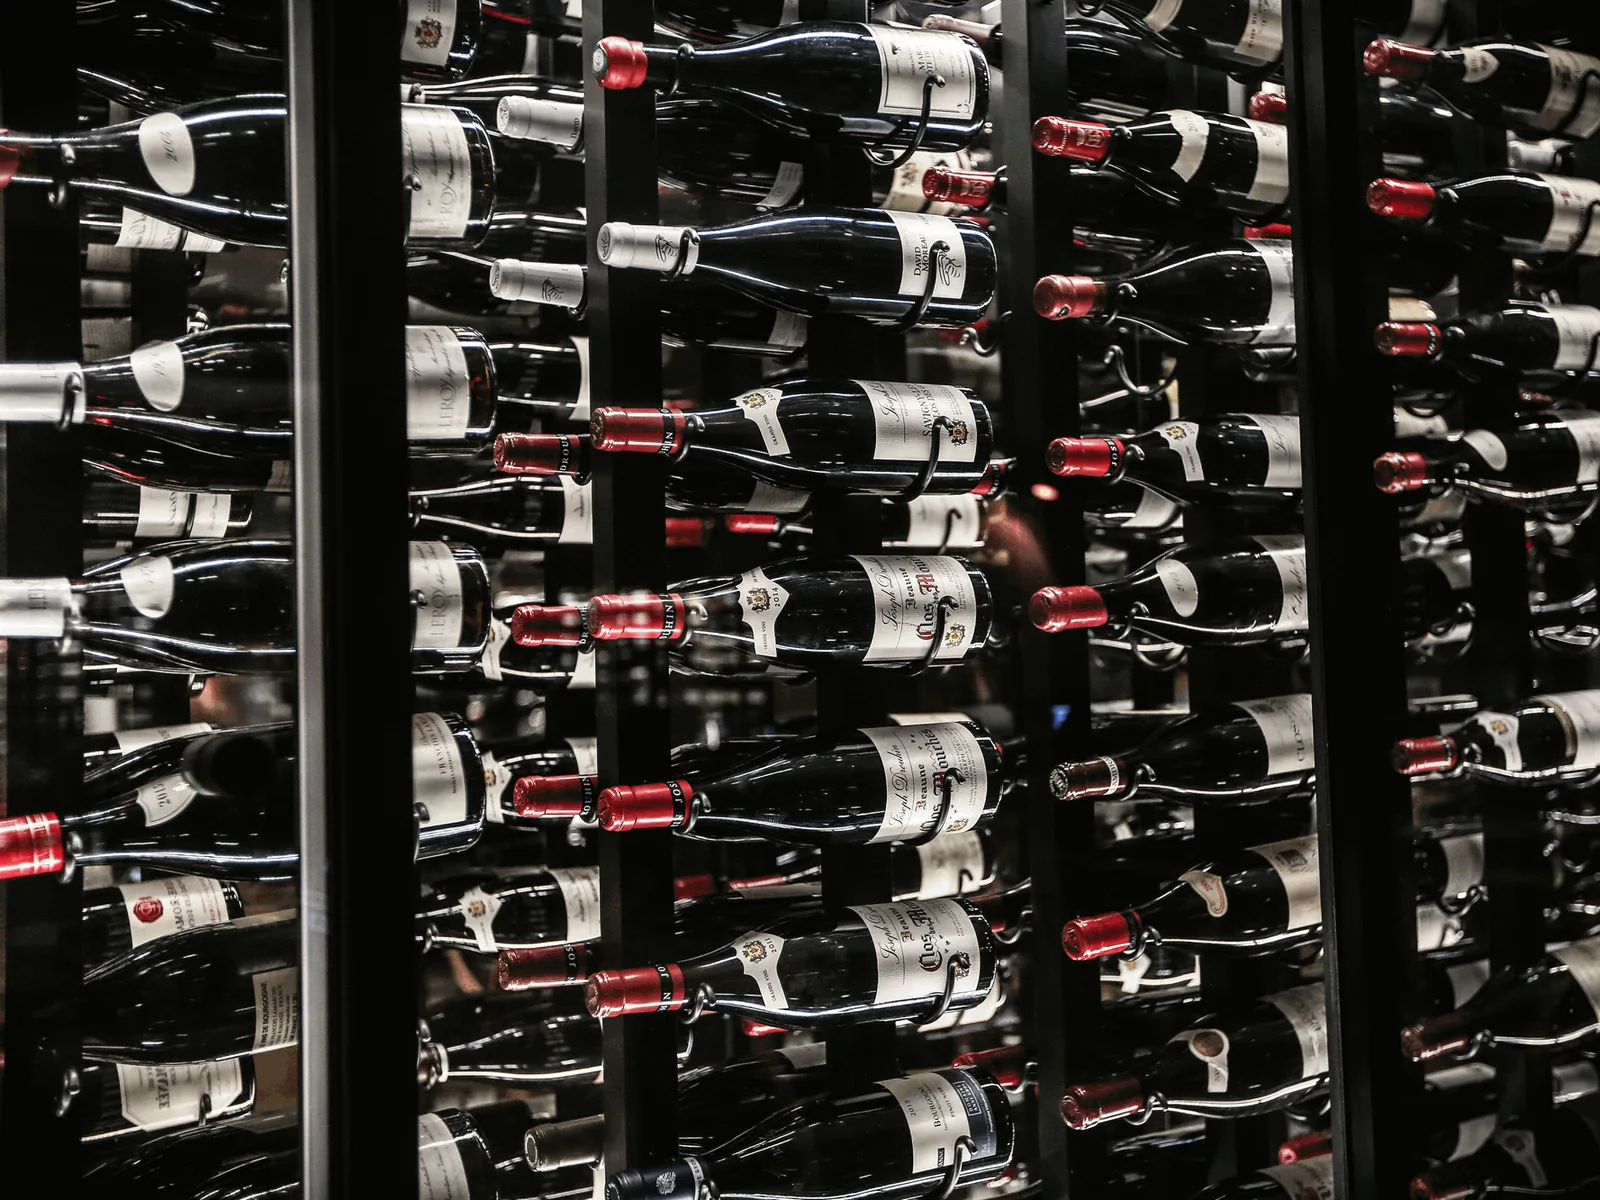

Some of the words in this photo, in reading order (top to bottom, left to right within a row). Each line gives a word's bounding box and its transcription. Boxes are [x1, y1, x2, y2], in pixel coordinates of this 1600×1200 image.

[570, 118, 580, 139] DAVID
[913, 246, 922, 277] DAVID
[919, 233, 930, 272] MOREAU
[438, 378, 457, 427] LEROY
[763, 414, 772, 425] VINS
[769, 426, 779, 445] GRANDS
[772, 587, 781, 608] 2014
[898, 567, 917, 611] Beaune
[430, 586, 448, 635] LEROY
[881, 588, 901, 631] Joseph
[915, 603, 936, 641] Clos
[921, 728, 949, 796] Mouches
[1292, 724, 1306, 762] CLOS
[886, 743, 909, 791] Drouhin
[153, 783, 171, 807] 2015
[580, 776, 593, 815] ROUHIN
[914, 763, 928, 812] Beaune
[888, 791, 911, 829] Joseph
[873, 924, 900, 964] Joseph
[888, 907, 914, 943] Beaune
[765, 937, 777, 953] 2011
[918, 933, 942, 972] Clos
[762, 969, 770, 981] VINS
[767, 982, 777, 1002] GRANDS
[260, 982, 269, 1024] BOURGOGNE
[262, 1025, 269, 1033] DE
[904, 1099, 916, 1117] 2015
[918, 1086, 941, 1128] BOURGOGNE
[945, 1100, 956, 1117] PINOT
[956, 1084, 973, 1112] DOMAINE
[967, 1096, 978, 1112] ANNE
